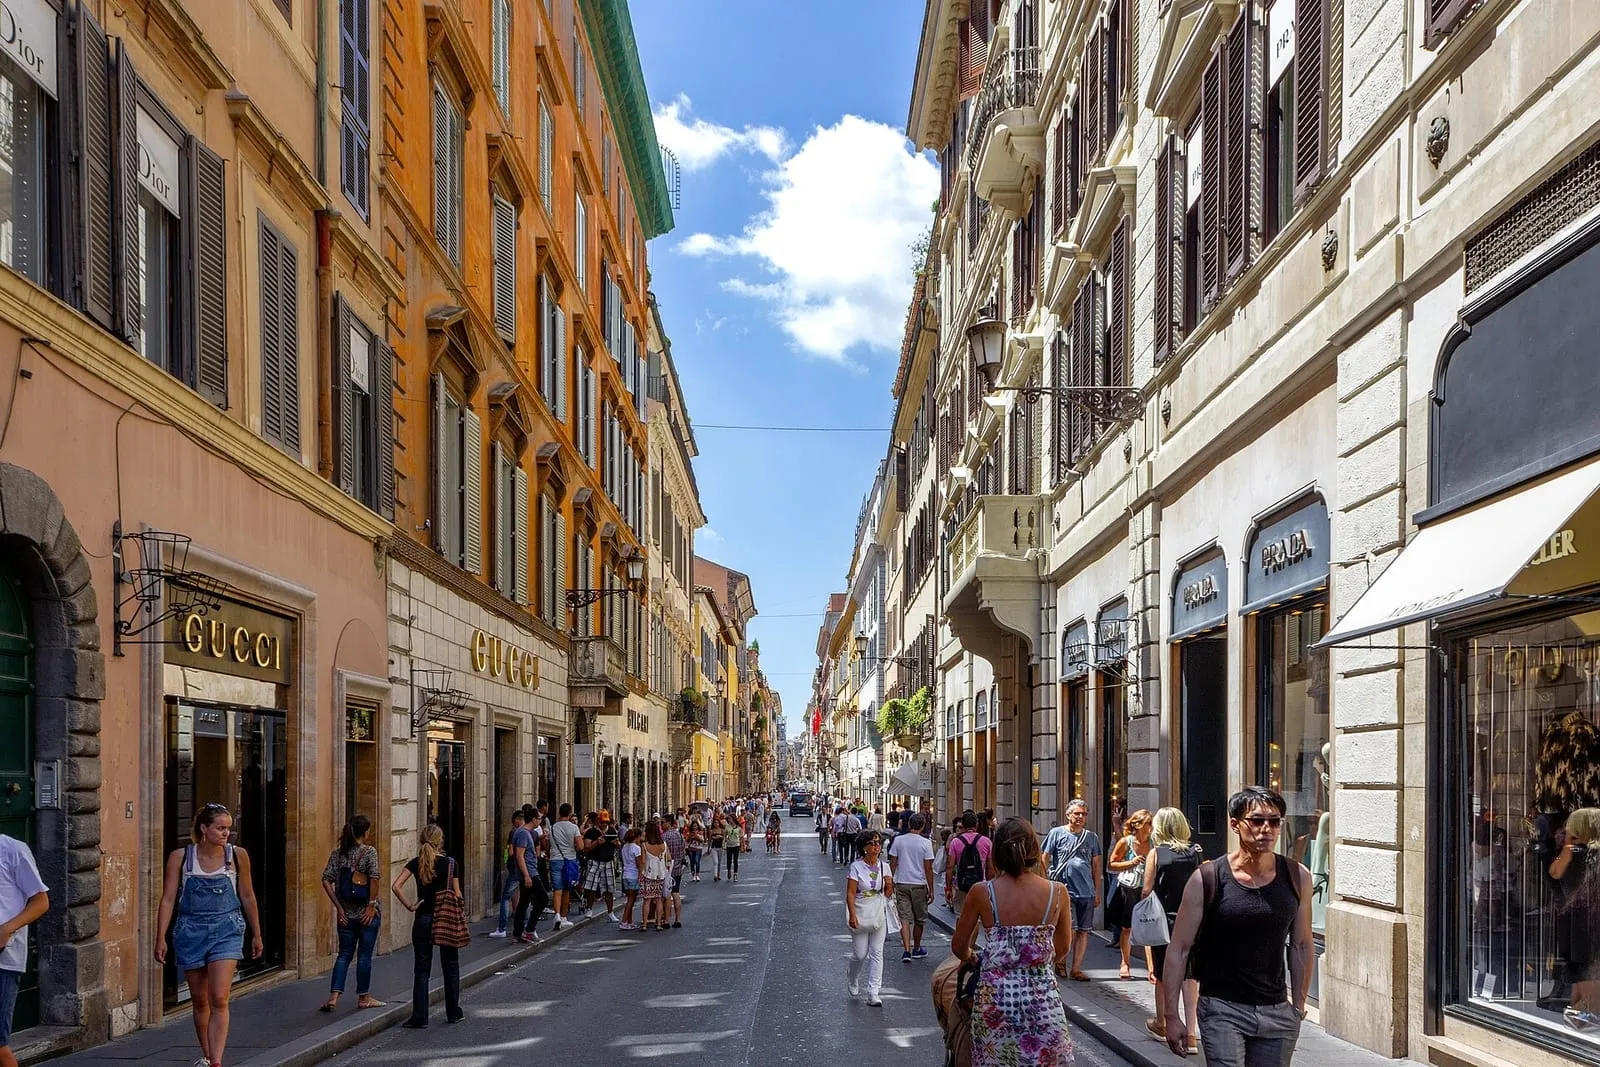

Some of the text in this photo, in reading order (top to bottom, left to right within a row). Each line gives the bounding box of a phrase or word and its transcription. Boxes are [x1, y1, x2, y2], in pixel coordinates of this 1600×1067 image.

[138, 143, 170, 200] Dior
[1261, 529, 1313, 573] PRADA
[1184, 575, 1217, 608] PRADA
[184, 613, 280, 669] GUCCI
[471, 629, 540, 691] GUCCI
